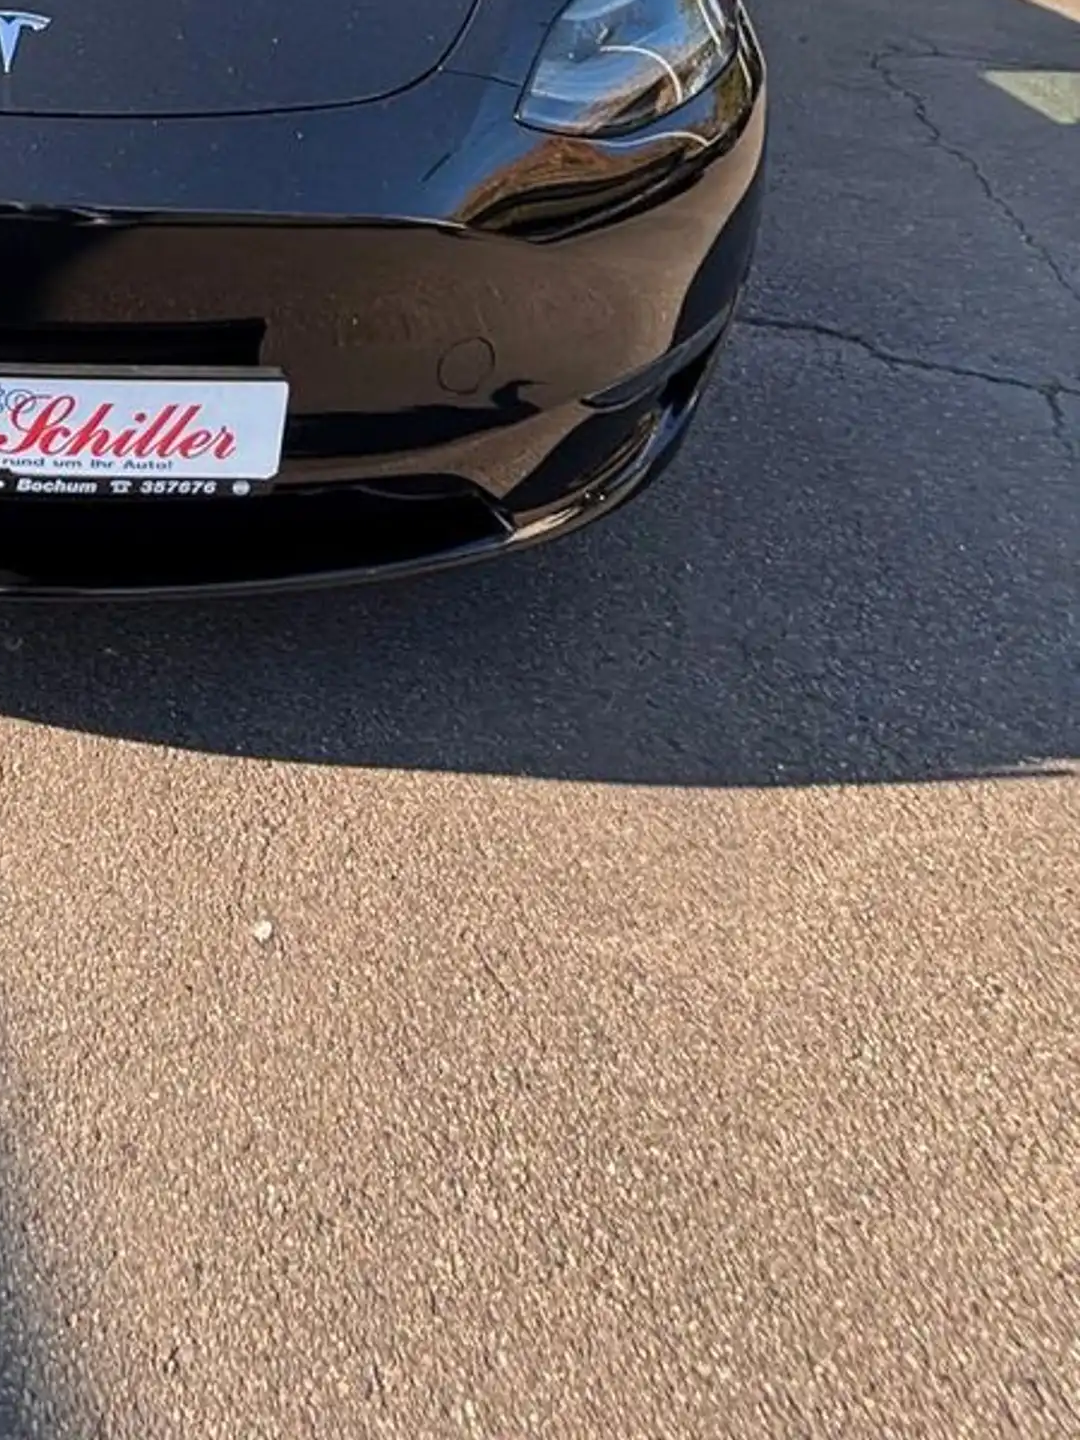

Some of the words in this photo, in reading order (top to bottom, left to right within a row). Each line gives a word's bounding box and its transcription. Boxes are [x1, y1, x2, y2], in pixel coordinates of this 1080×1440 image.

[2, 456, 45, 468] rund
[52, 459, 83, 469] um
[90, 459, 113, 470] Ihr
[122, 459, 174, 471] Auto!
[16, 477, 98, 495] Bochum
[139, 479, 218, 495] 357676
